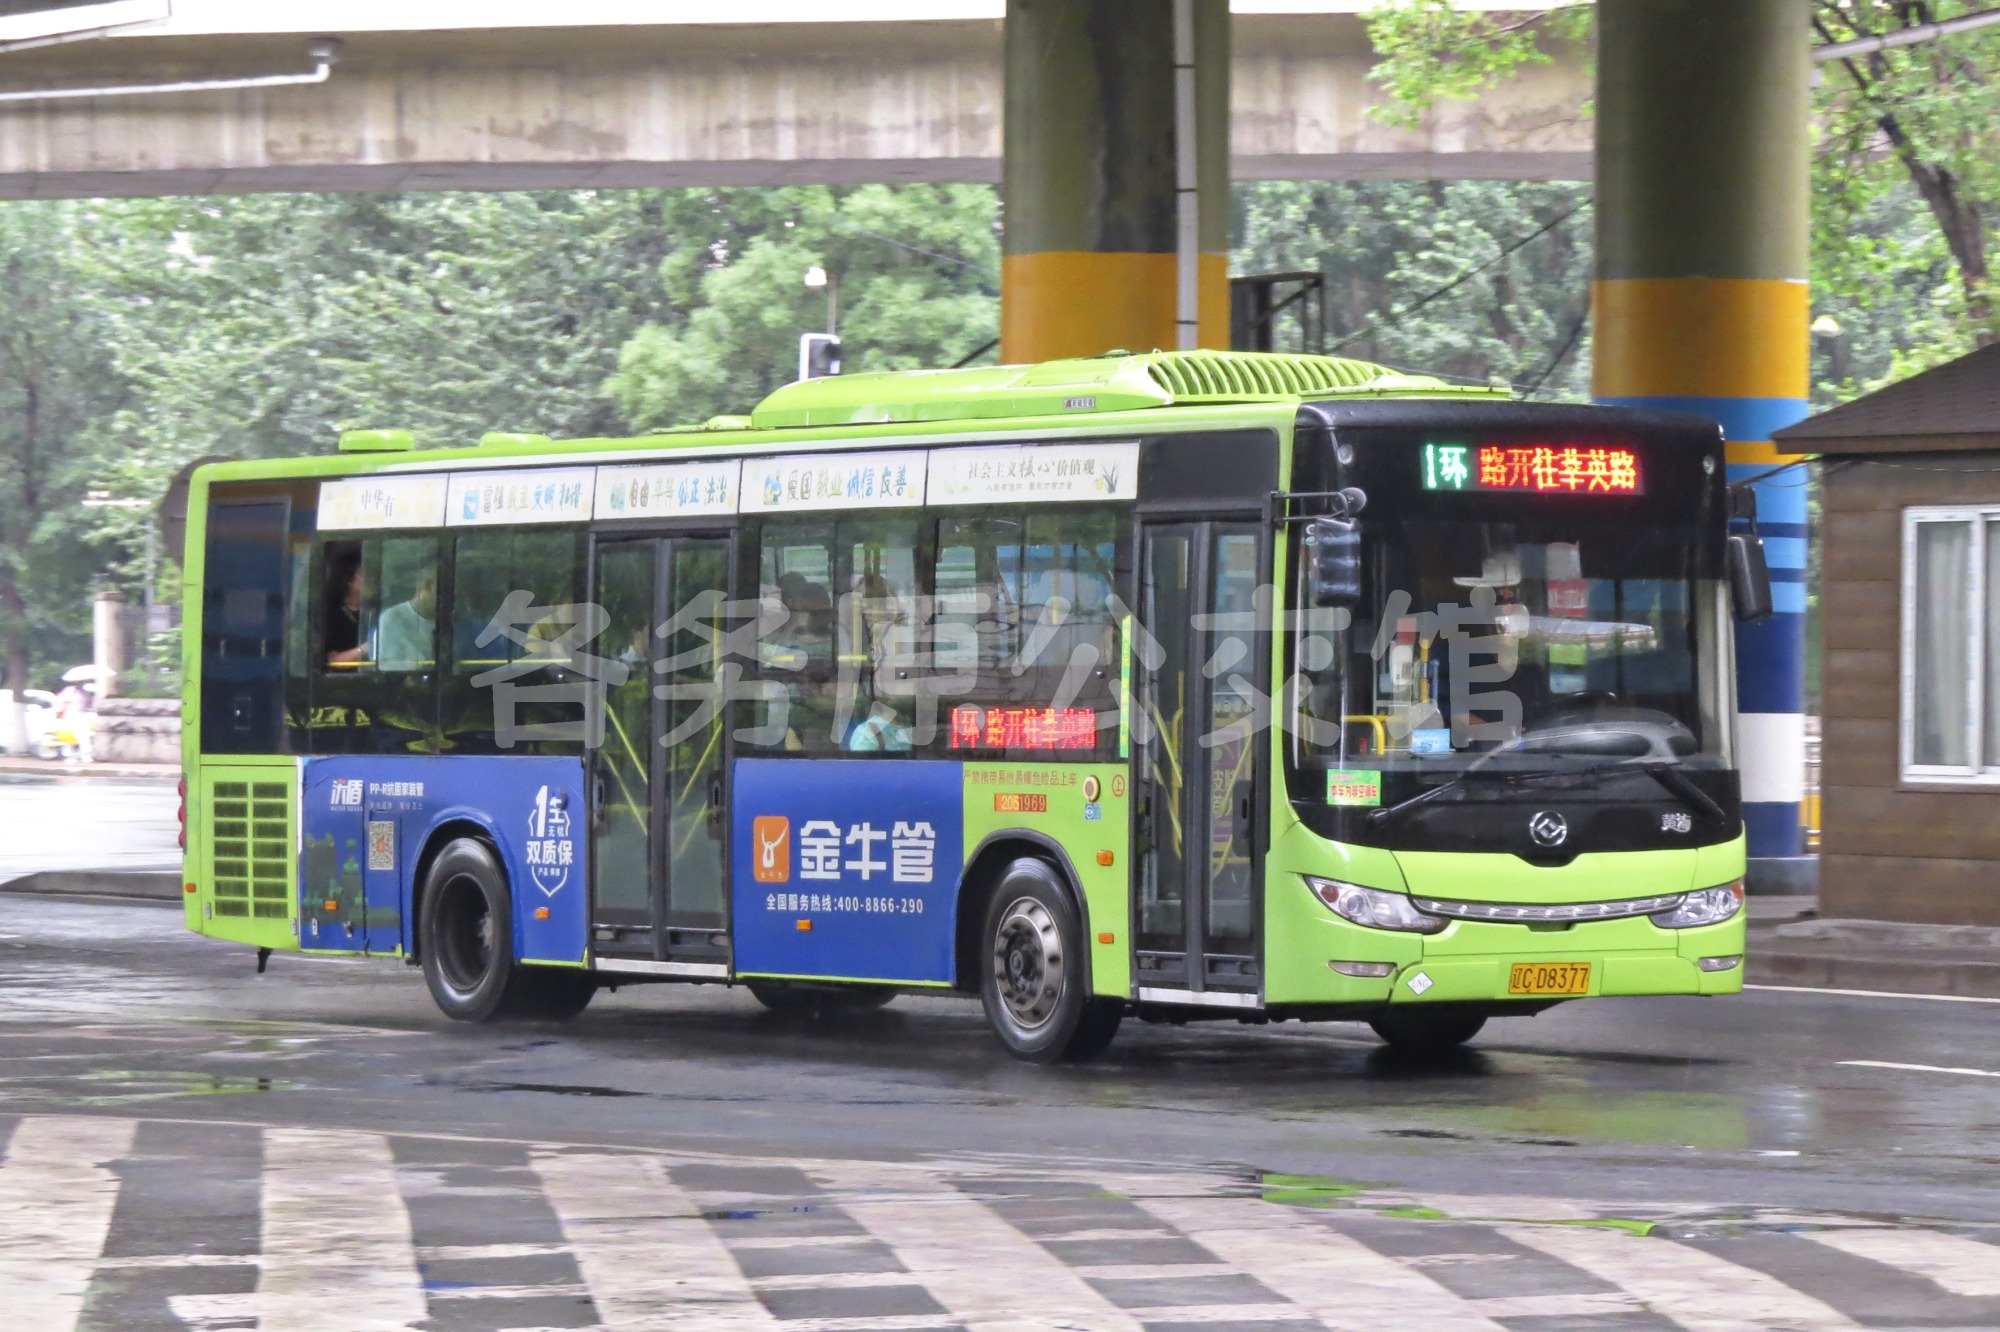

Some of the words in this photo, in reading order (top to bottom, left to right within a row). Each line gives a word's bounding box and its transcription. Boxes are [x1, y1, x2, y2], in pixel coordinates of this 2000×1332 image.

[969, 456, 1095, 479] 社会主义核心价值观
[526, 839, 573, 866] 双质保
[800, 820, 936, 882] 金牛管
